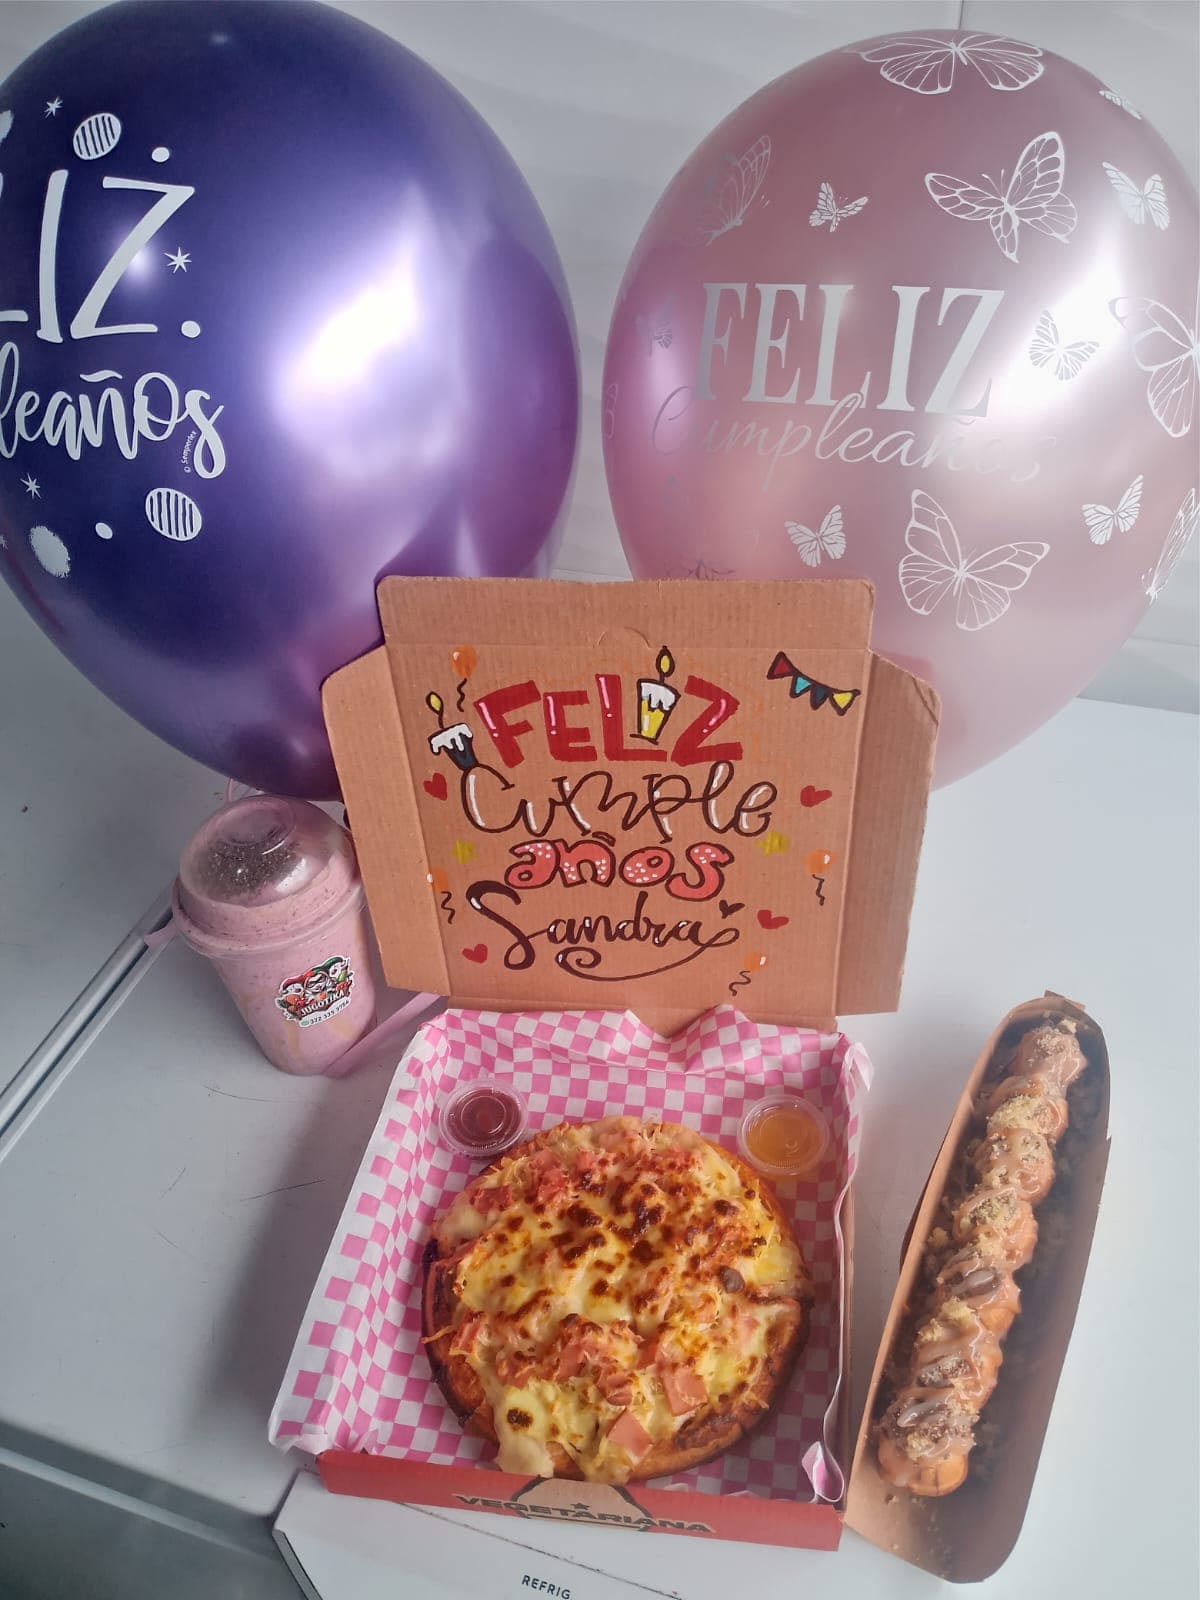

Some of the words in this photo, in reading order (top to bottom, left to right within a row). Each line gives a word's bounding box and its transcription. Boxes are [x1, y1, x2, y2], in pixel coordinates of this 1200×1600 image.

[695, 282, 1005, 418] FELIZ
[652, 391, 1058, 492] Cumpleaños
[460, 760, 778, 844] Cumple
[503, 831, 735, 901] años
[465, 880, 741, 982] Sandra
[300, 989, 345, 1016] JUGOTIKA
[452, 1493, 717, 1533] VEGETARIANA
